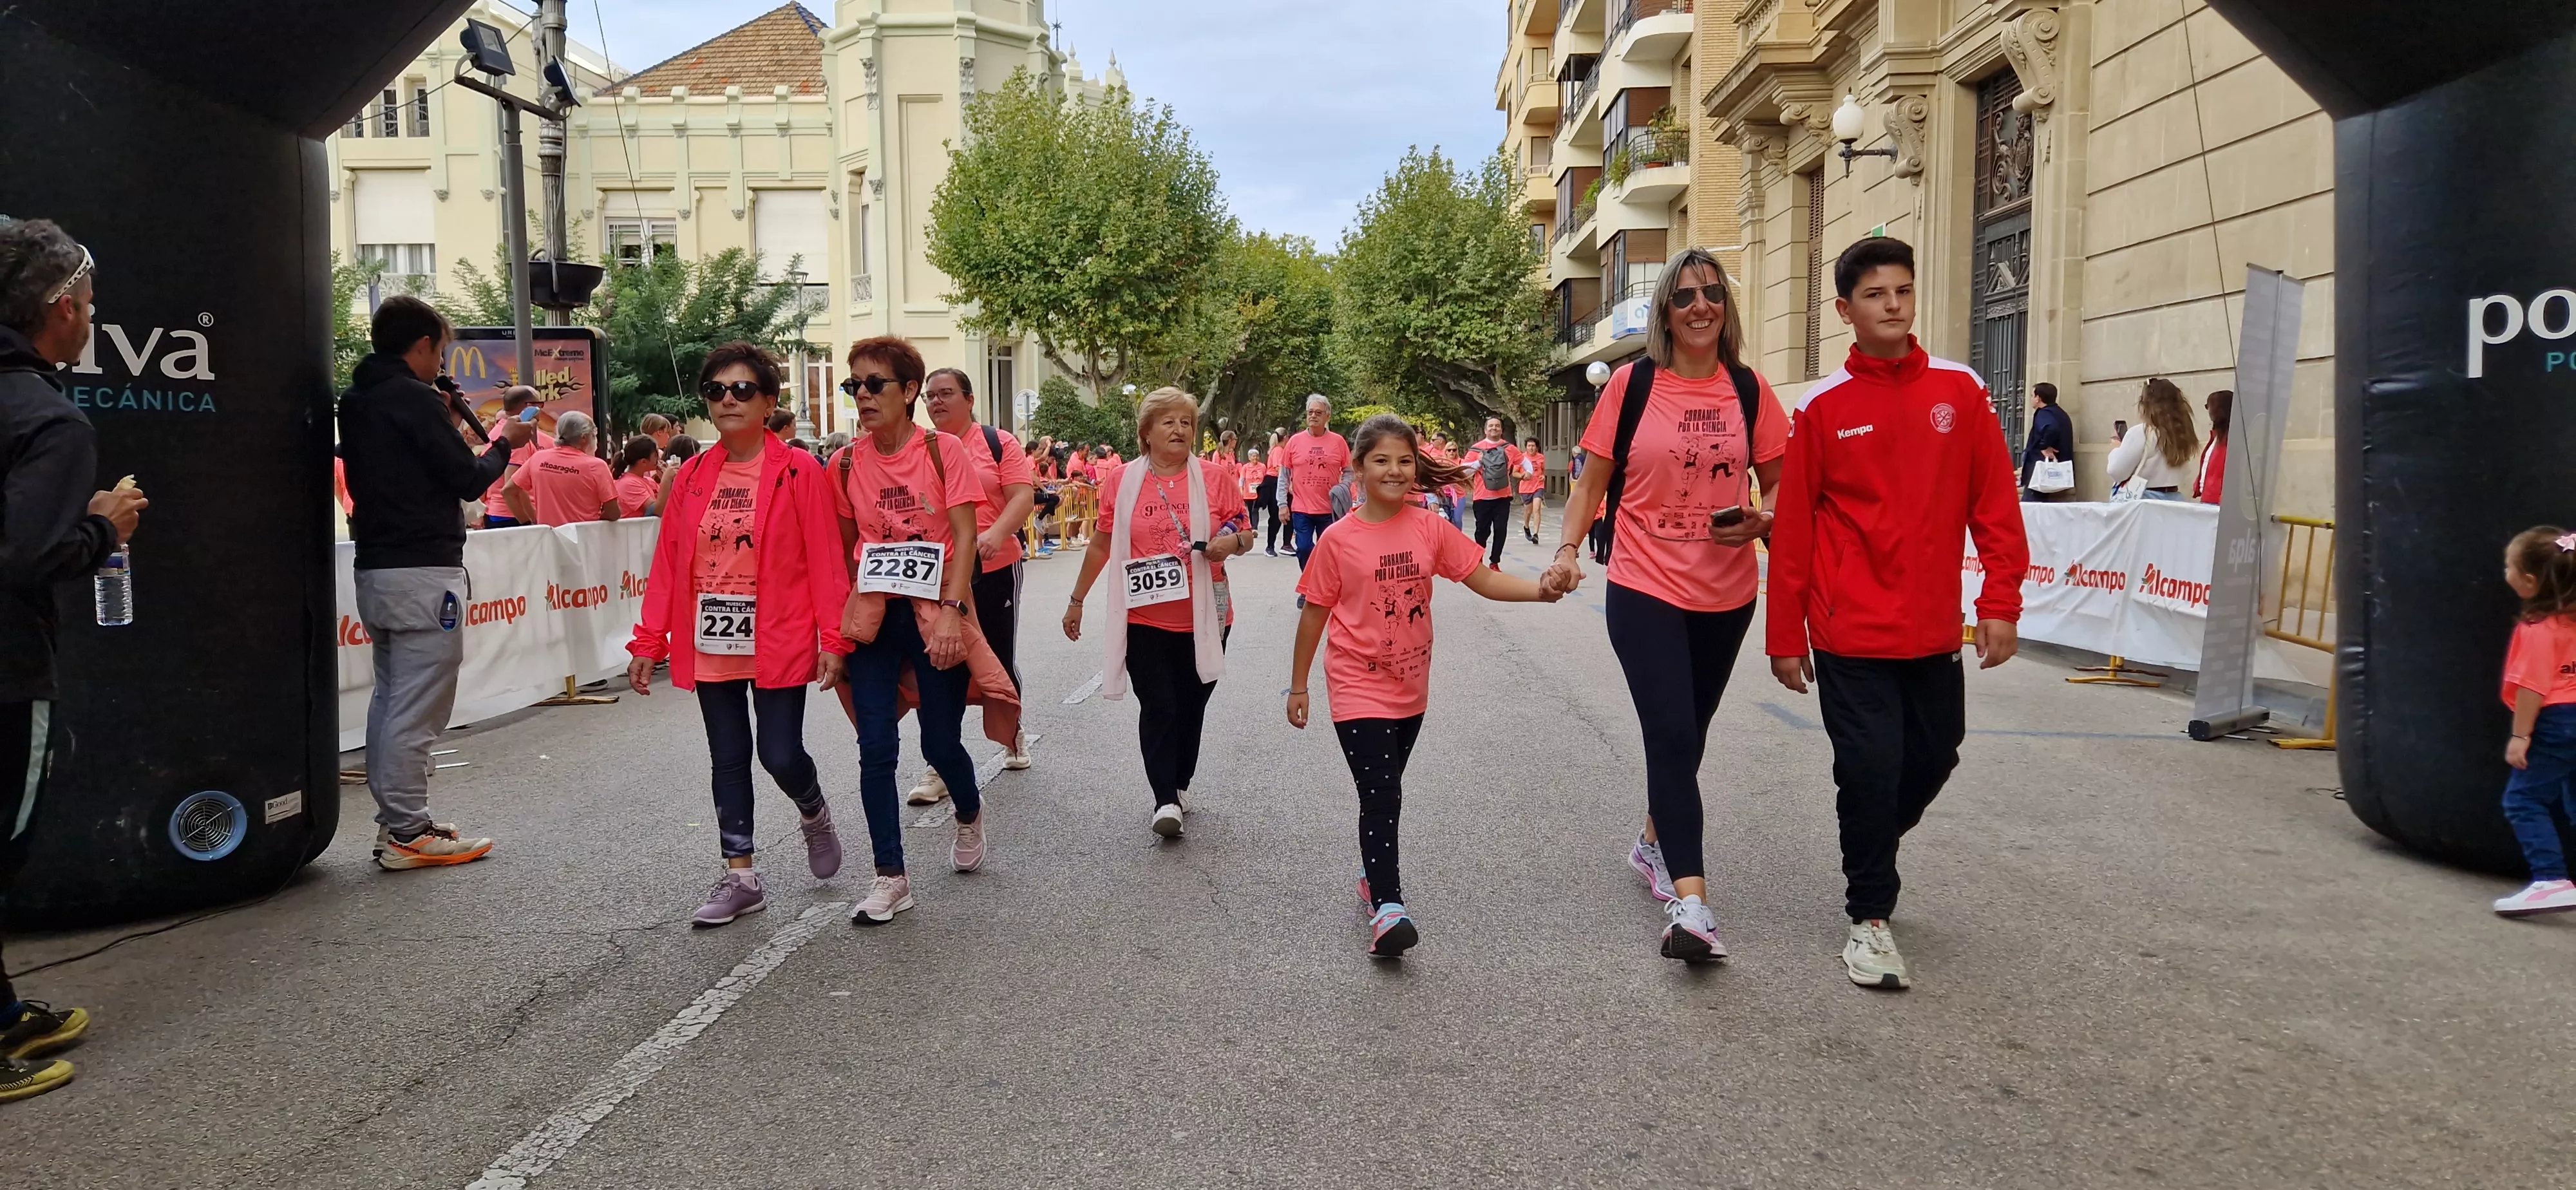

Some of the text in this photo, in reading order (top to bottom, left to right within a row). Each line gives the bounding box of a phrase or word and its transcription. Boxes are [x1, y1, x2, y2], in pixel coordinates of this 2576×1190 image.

[55, 305, 215, 380] iva
[66, 383, 216, 413] ECÁNICA
[1684, 409, 1720, 422] CORRAMOS
[1678, 420, 1727, 433] POR LA CIENCIA
[1837, 424, 1873, 440] Kempa
[909, 550, 936, 559] CÁNCER
[1379, 551, 1414, 568] CORRAMOS
[867, 558, 936, 581] 2287
[1130, 566, 1150, 574] CONTRA
[1157, 560, 1179, 569] CÁNCER
[1375, 568, 1387, 583] POR
[1388, 567, 1395, 580] LA
[1396, 563, 1420, 579] CIENCIA
[1130, 568, 1181, 594] 3059
[2065, 560, 2126, 595] Alcampo
[465, 596, 526, 625] lcampo
